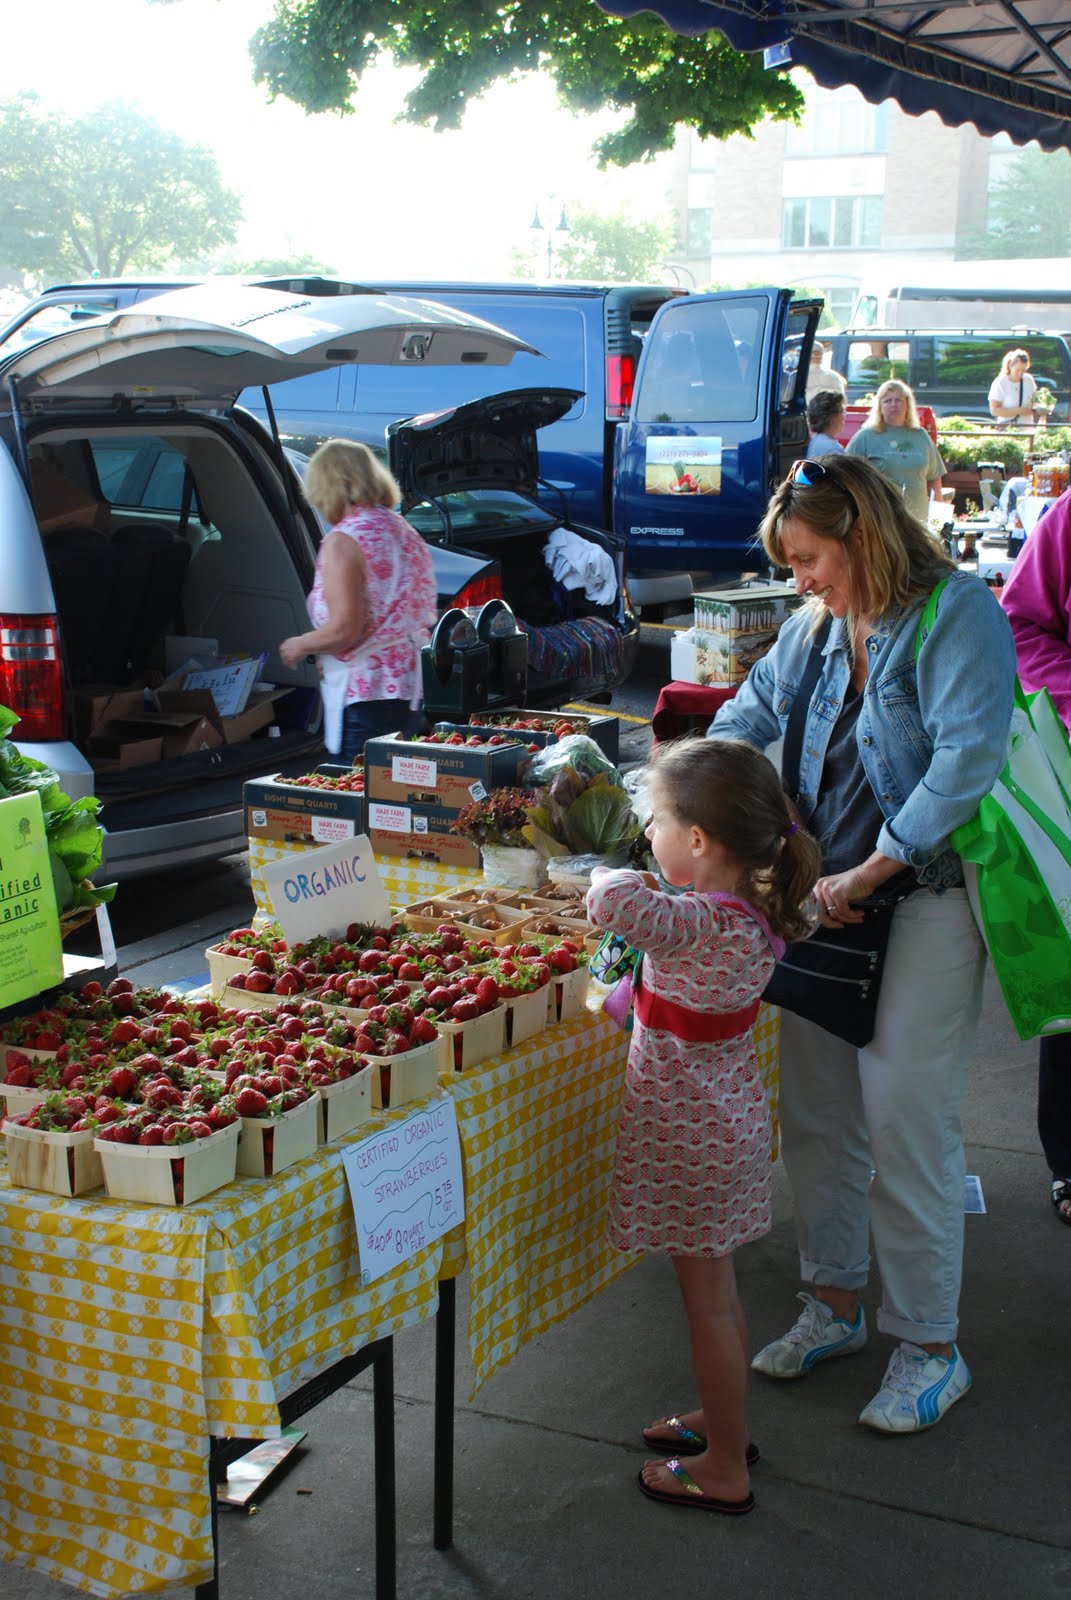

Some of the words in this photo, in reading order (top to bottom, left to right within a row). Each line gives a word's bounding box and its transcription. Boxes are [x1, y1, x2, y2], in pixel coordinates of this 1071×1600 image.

[630, 526, 684, 536] EXPRESS
[399, 761, 414, 769] WARE
[415, 763, 430, 771] FARM
[264, 793, 286, 803] EIGHT
[306, 799, 337, 810] QUARTS
[283, 855, 366, 903] ORGANIC
[357, 1137, 399, 1170] CERTIFIED
[404, 1111, 444, 1144] ORGANIC
[374, 1152, 448, 1203] STRAWBERRIES
[395, 1229, 403, 1254] 8
[403, 1221, 424, 1243] QUART
[410, 1236, 426, 1250] FLAT
